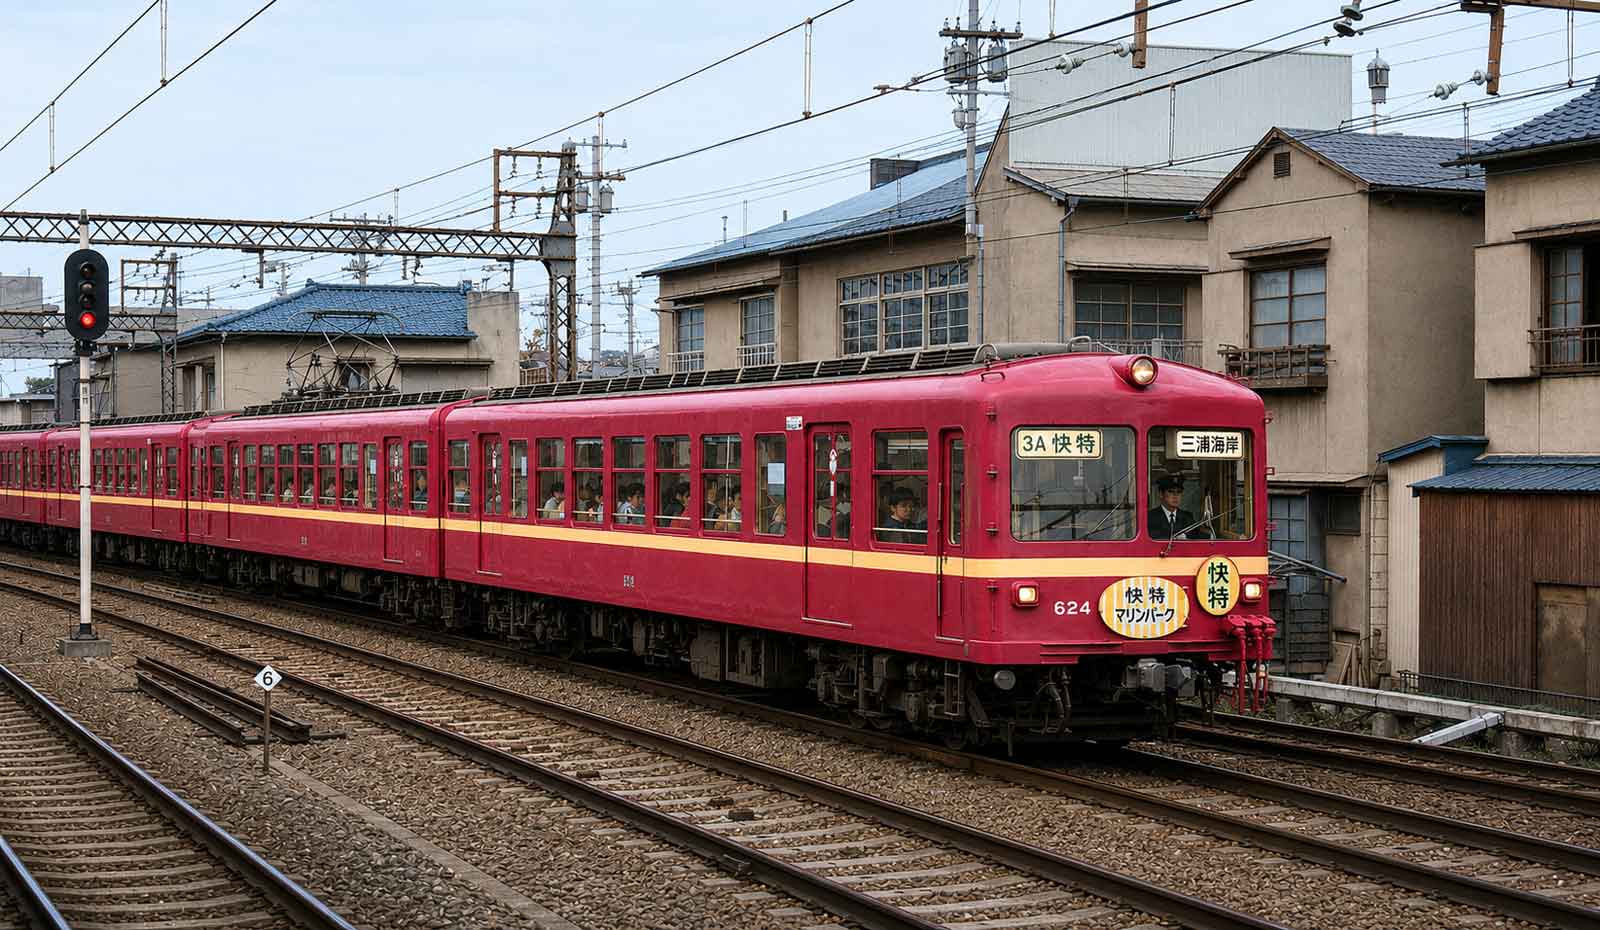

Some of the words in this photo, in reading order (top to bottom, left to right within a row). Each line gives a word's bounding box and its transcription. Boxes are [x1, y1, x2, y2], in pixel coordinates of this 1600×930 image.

[1023, 435, 1046, 452] 3A
[1052, 433, 1096, 454] 快特
[1181, 435, 1239, 454] 三浦海岸
[1208, 562, 1229, 609] 快特
[1125, 586, 1166, 604] 快特
[1054, 601, 1091, 615] 624
[1115, 607, 1175, 624] マリンパーク
[263, 671, 273, 686] 6
